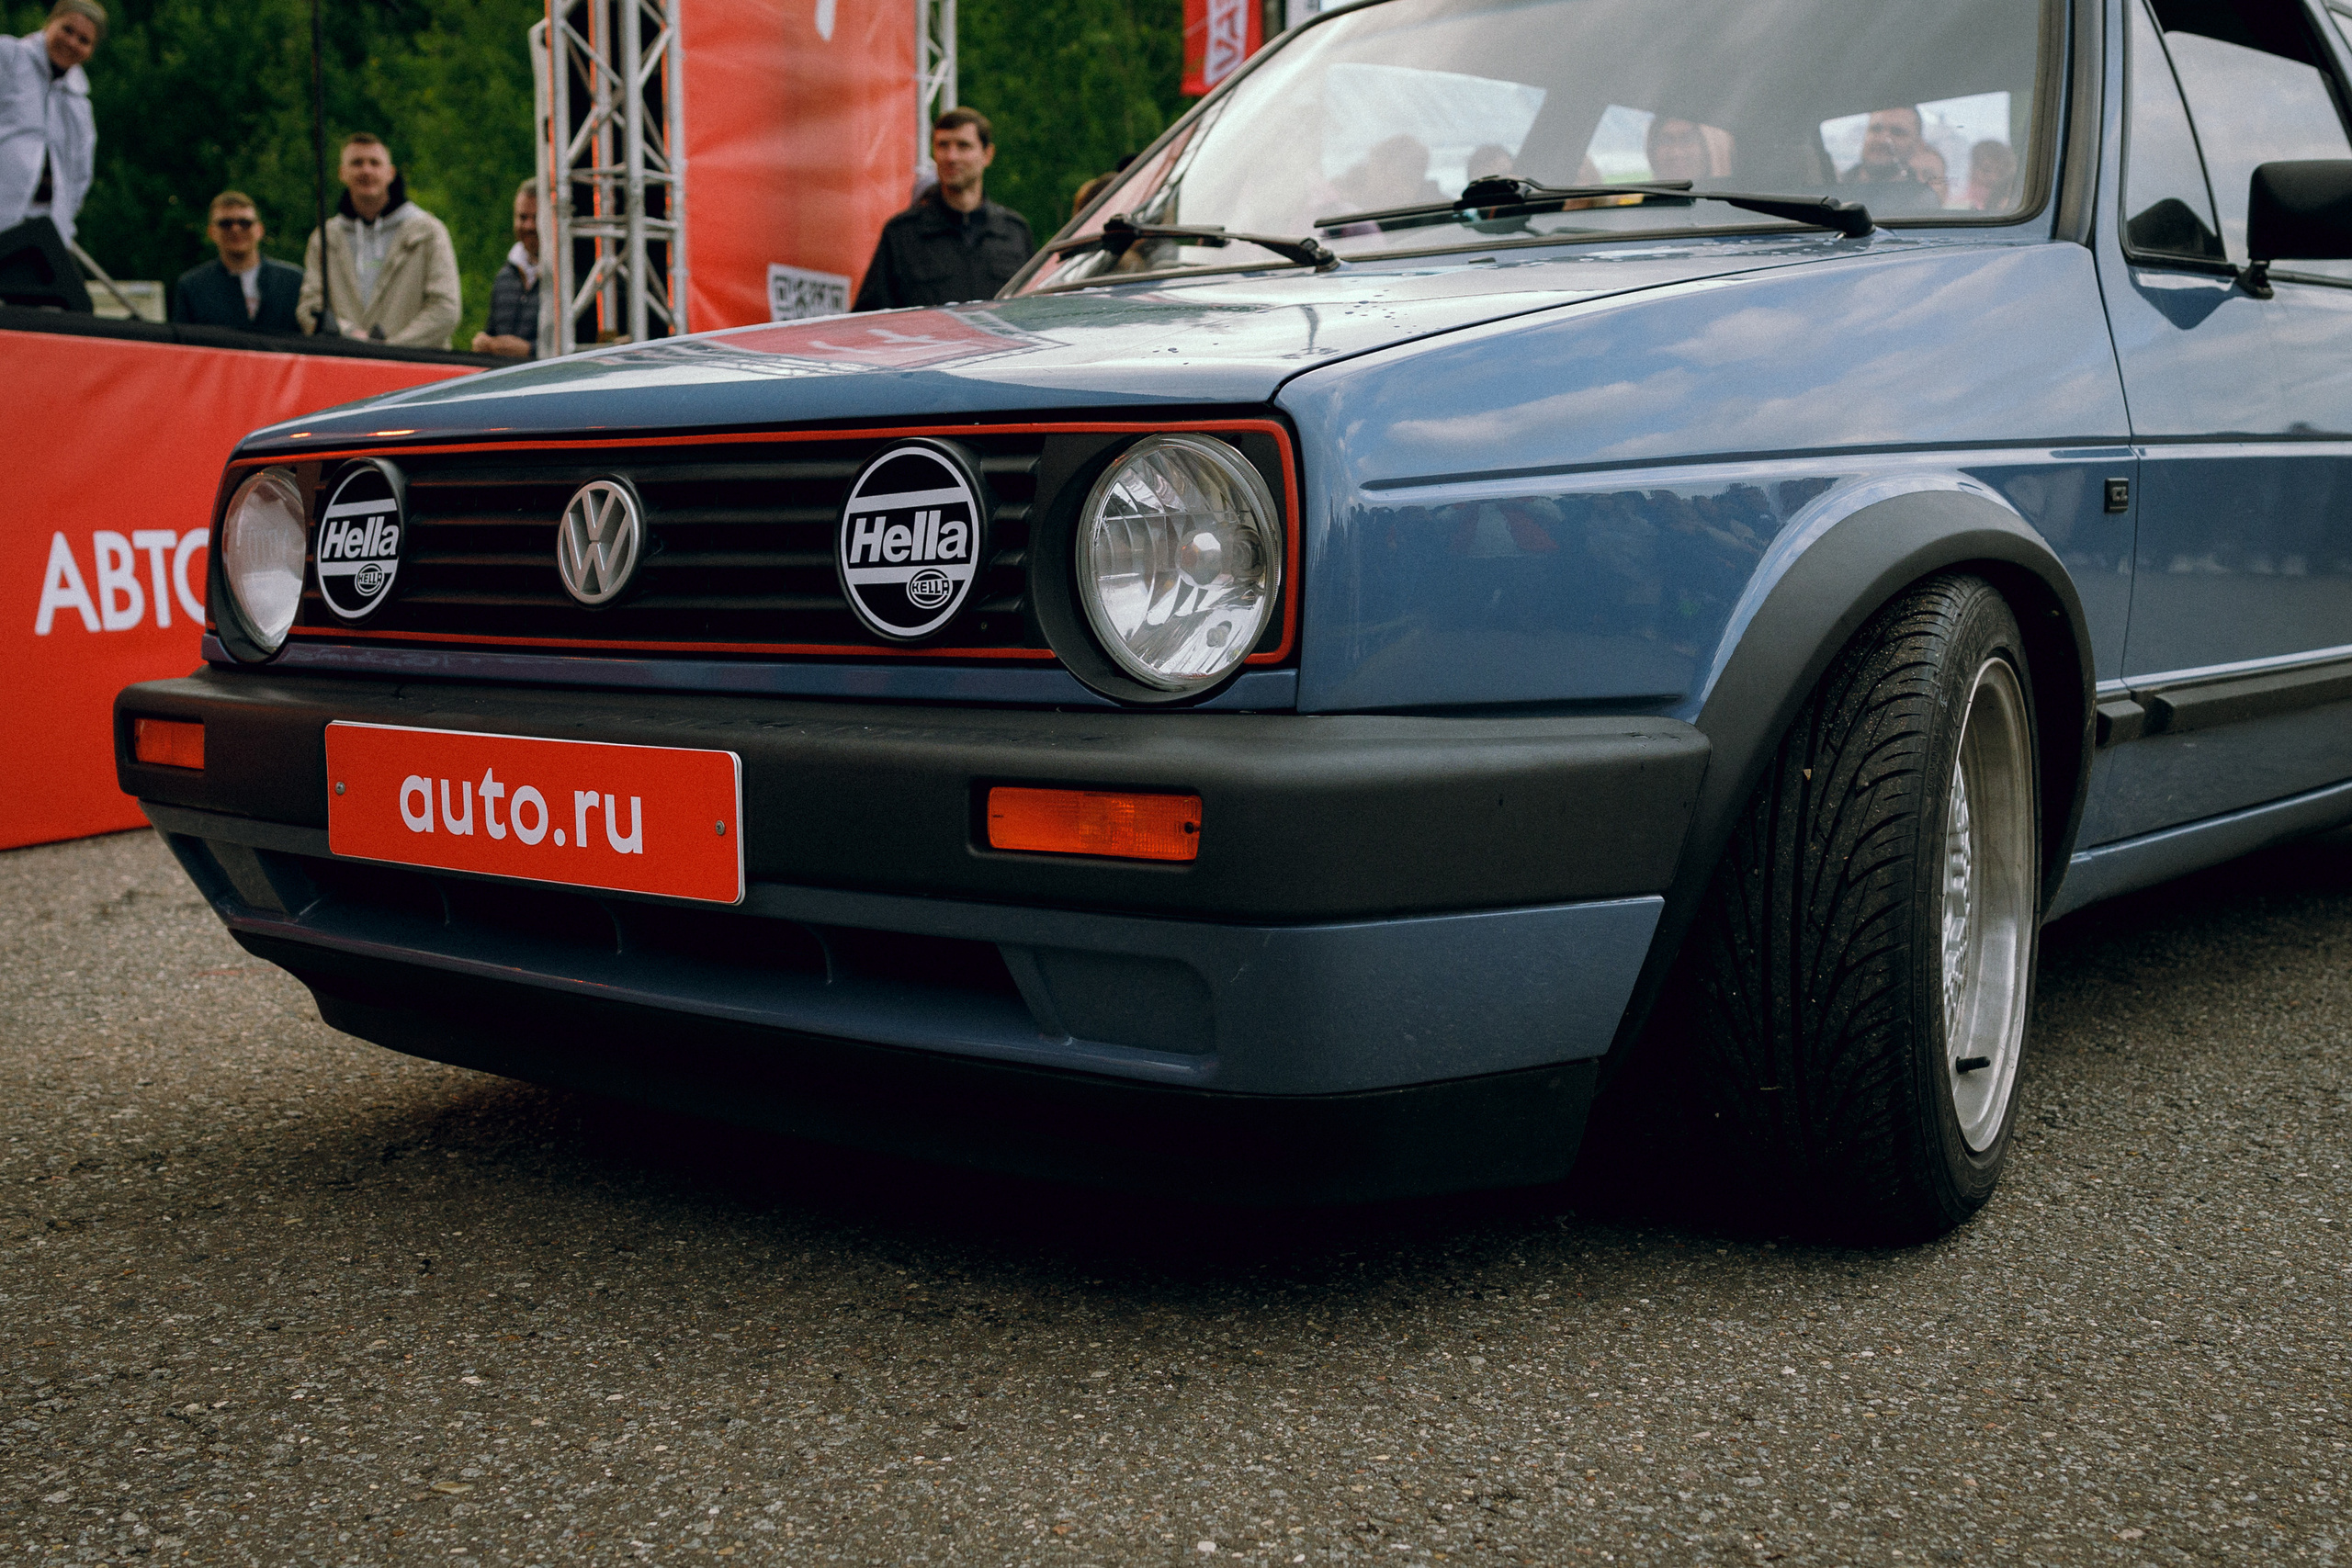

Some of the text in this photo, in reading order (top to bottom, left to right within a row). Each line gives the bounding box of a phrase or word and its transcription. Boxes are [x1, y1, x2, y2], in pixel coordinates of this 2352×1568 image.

[322, 515, 400, 559] Hella
[559, 481, 639, 604] VW
[849, 509, 968, 564] Hella
[357, 572, 382, 584] HELLA
[911, 580, 950, 594] HELLA
[399, 767, 643, 855] auto.ru
